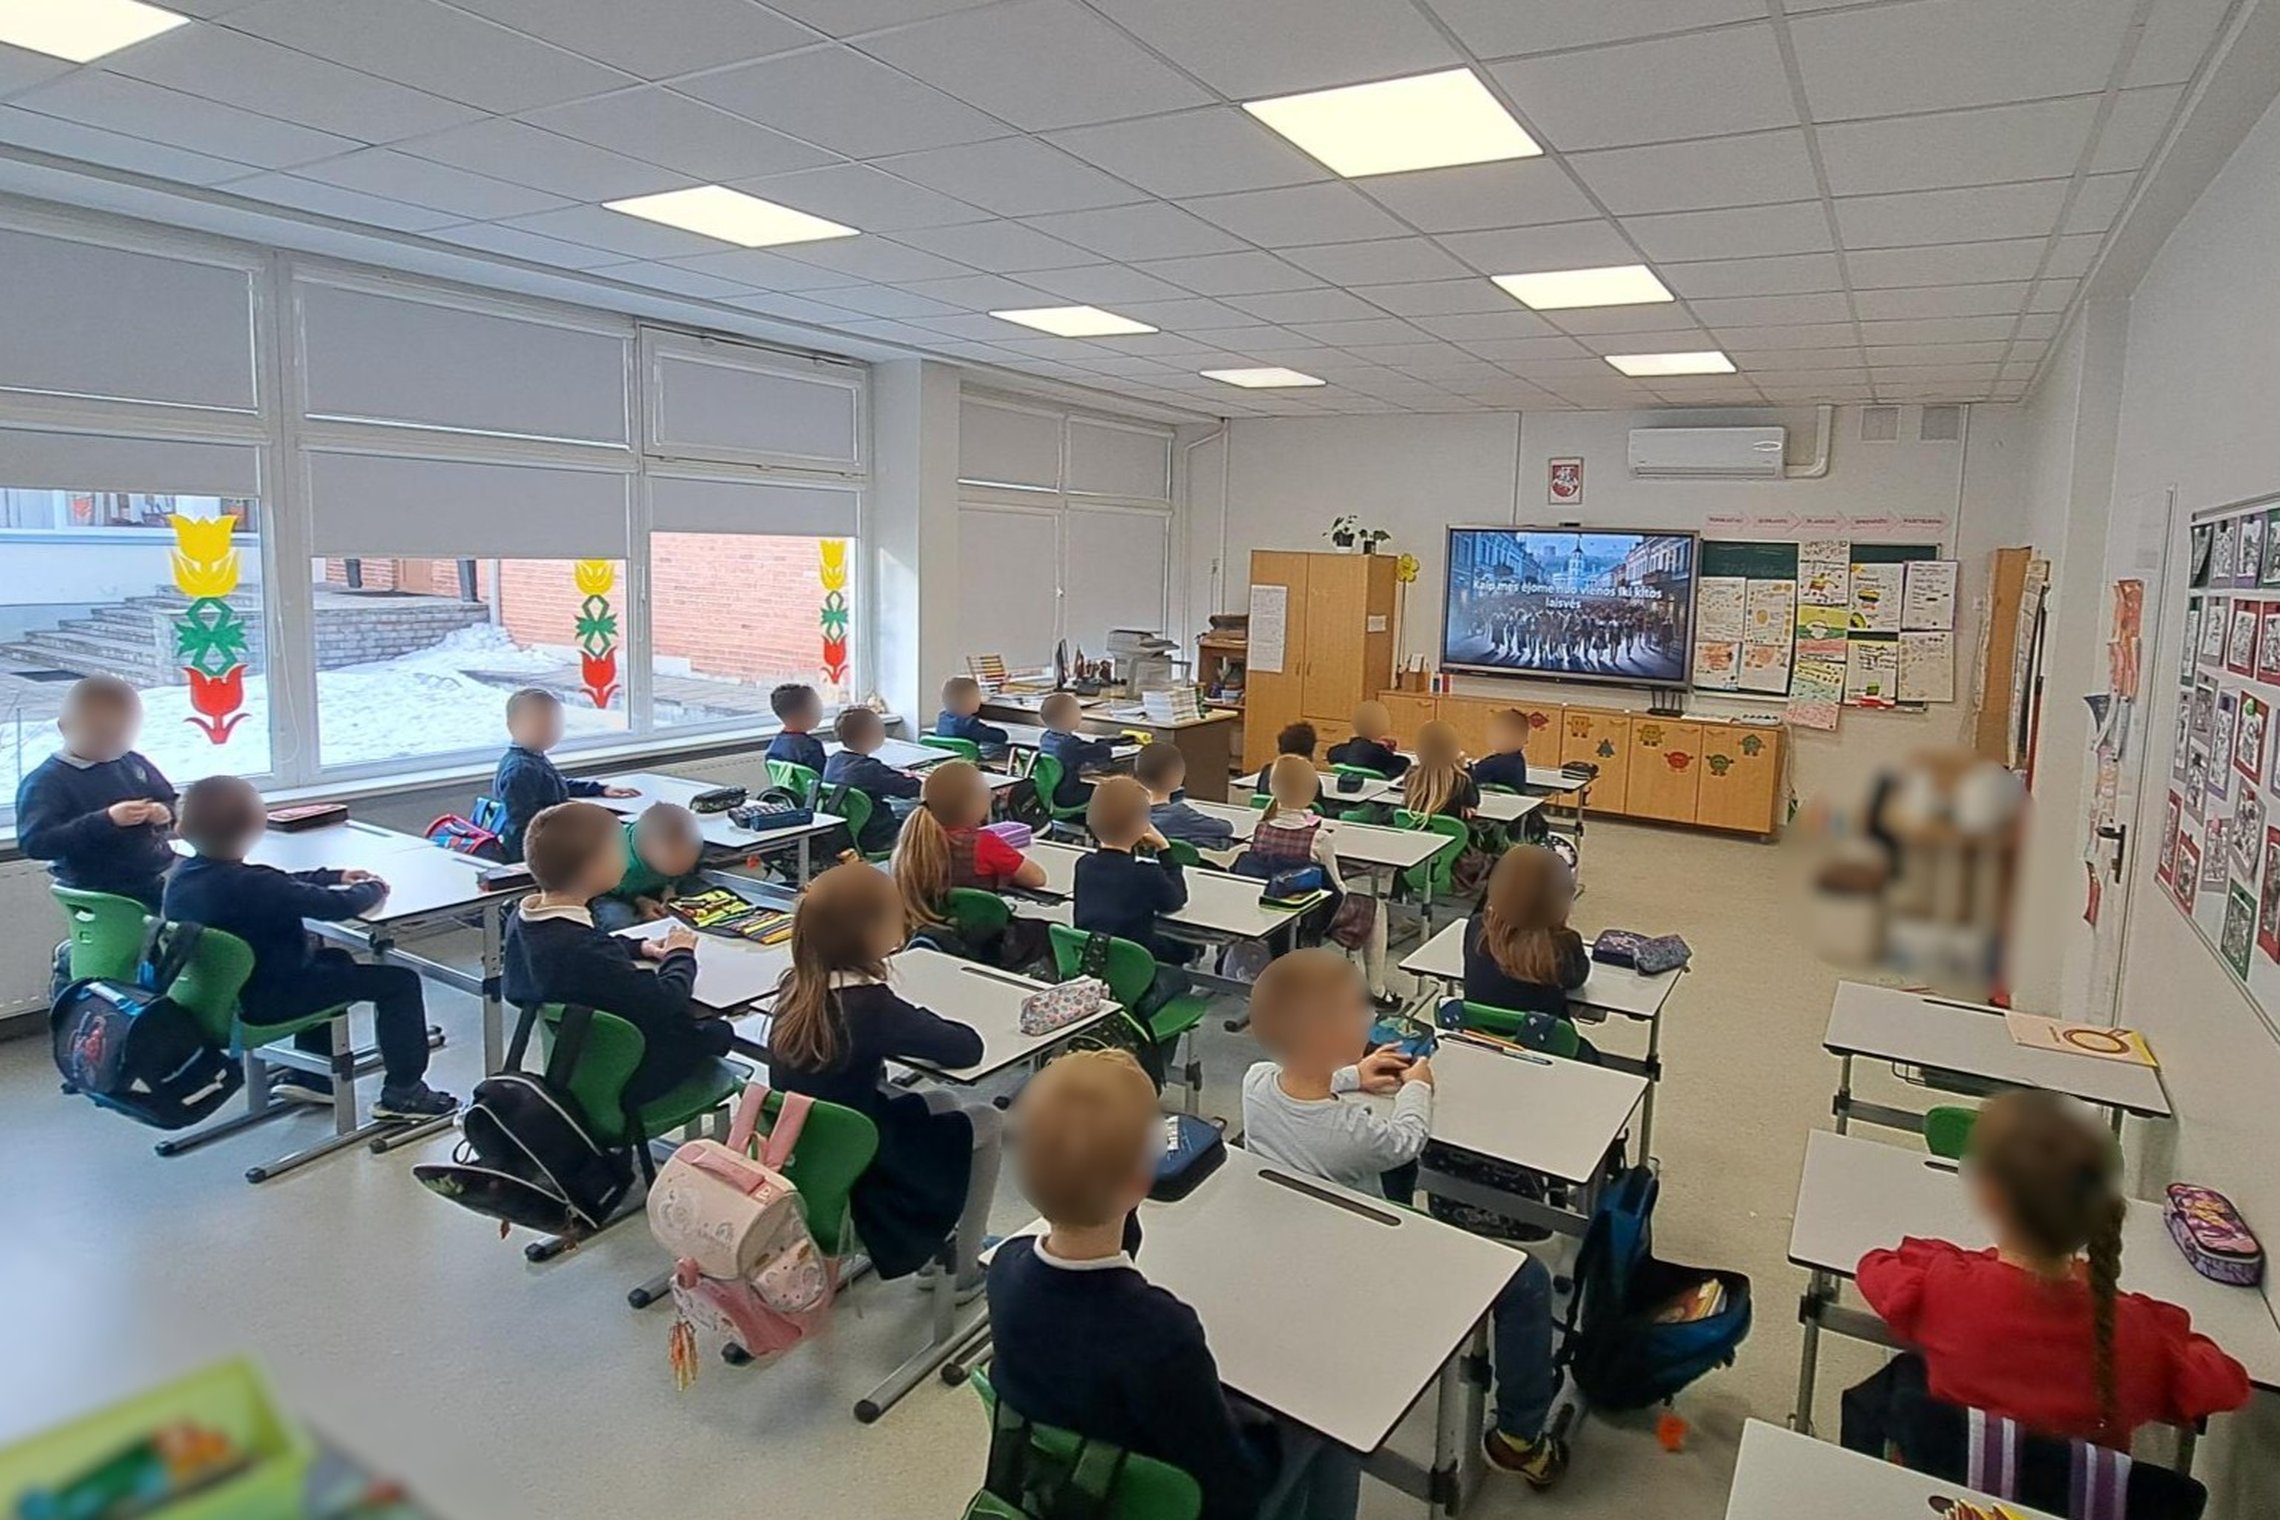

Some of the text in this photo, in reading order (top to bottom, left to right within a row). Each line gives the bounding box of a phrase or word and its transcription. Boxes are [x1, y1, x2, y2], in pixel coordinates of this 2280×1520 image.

[1473, 581, 1495, 592] Kaip
[1497, 583, 1519, 592] mes
[1556, 585, 1578, 594] nuo
[1580, 584, 1616, 597] vienos
[1634, 585, 1662, 599] kitos
